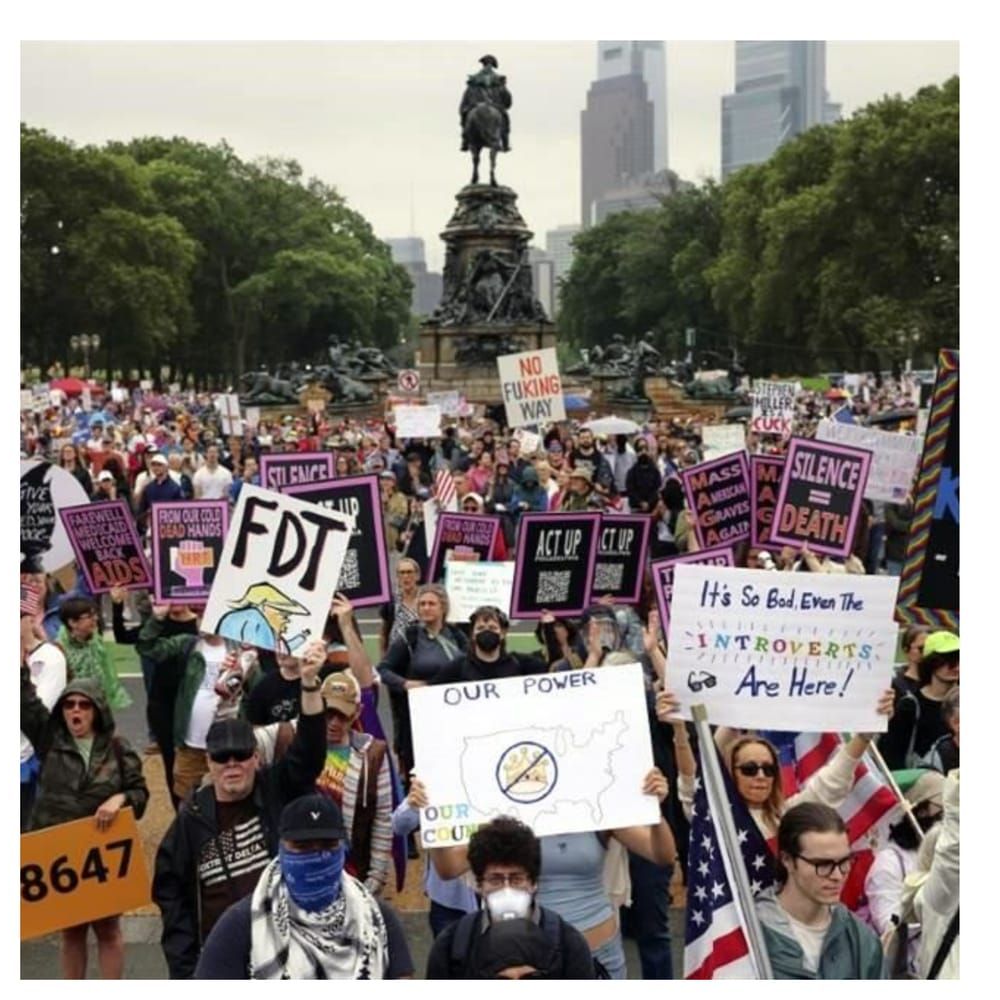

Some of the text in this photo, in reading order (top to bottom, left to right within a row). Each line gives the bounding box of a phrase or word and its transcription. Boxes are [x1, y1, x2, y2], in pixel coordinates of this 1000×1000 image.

[518, 356, 542, 378] NO
[504, 375, 560, 401] FUKING
[520, 399, 553, 420] WAY
[753, 416, 791, 432] CUCK
[690, 462, 743, 492] MASS
[791, 451, 861, 491] SILENCE
[68, 508, 124, 526] FAREWELL
[158, 508, 221, 523] FROM OUR COLD
[700, 498, 751, 529] GRAVES
[779, 503, 849, 544] DEATH
[72, 521, 129, 539] MEDICAID
[79, 534, 134, 551] WELCOME
[187, 523, 222, 538] HANDS
[230, 495, 348, 592] FDT
[536, 528, 582, 557] ACT UP
[599, 527, 634, 551] CT UP
[91, 557, 145, 586] AIDS
[741, 584, 760, 606] So
[800, 591, 836, 611] Even
[840, 592, 864, 612] The
[696, 632, 874, 660] INTROVERTS
[443, 671, 597, 706] OUR POWER
[734, 664, 780, 698] Are
[424, 803, 470, 821] OUR
[423, 822, 480, 844] COUN
[21, 838, 133, 903] 8647
